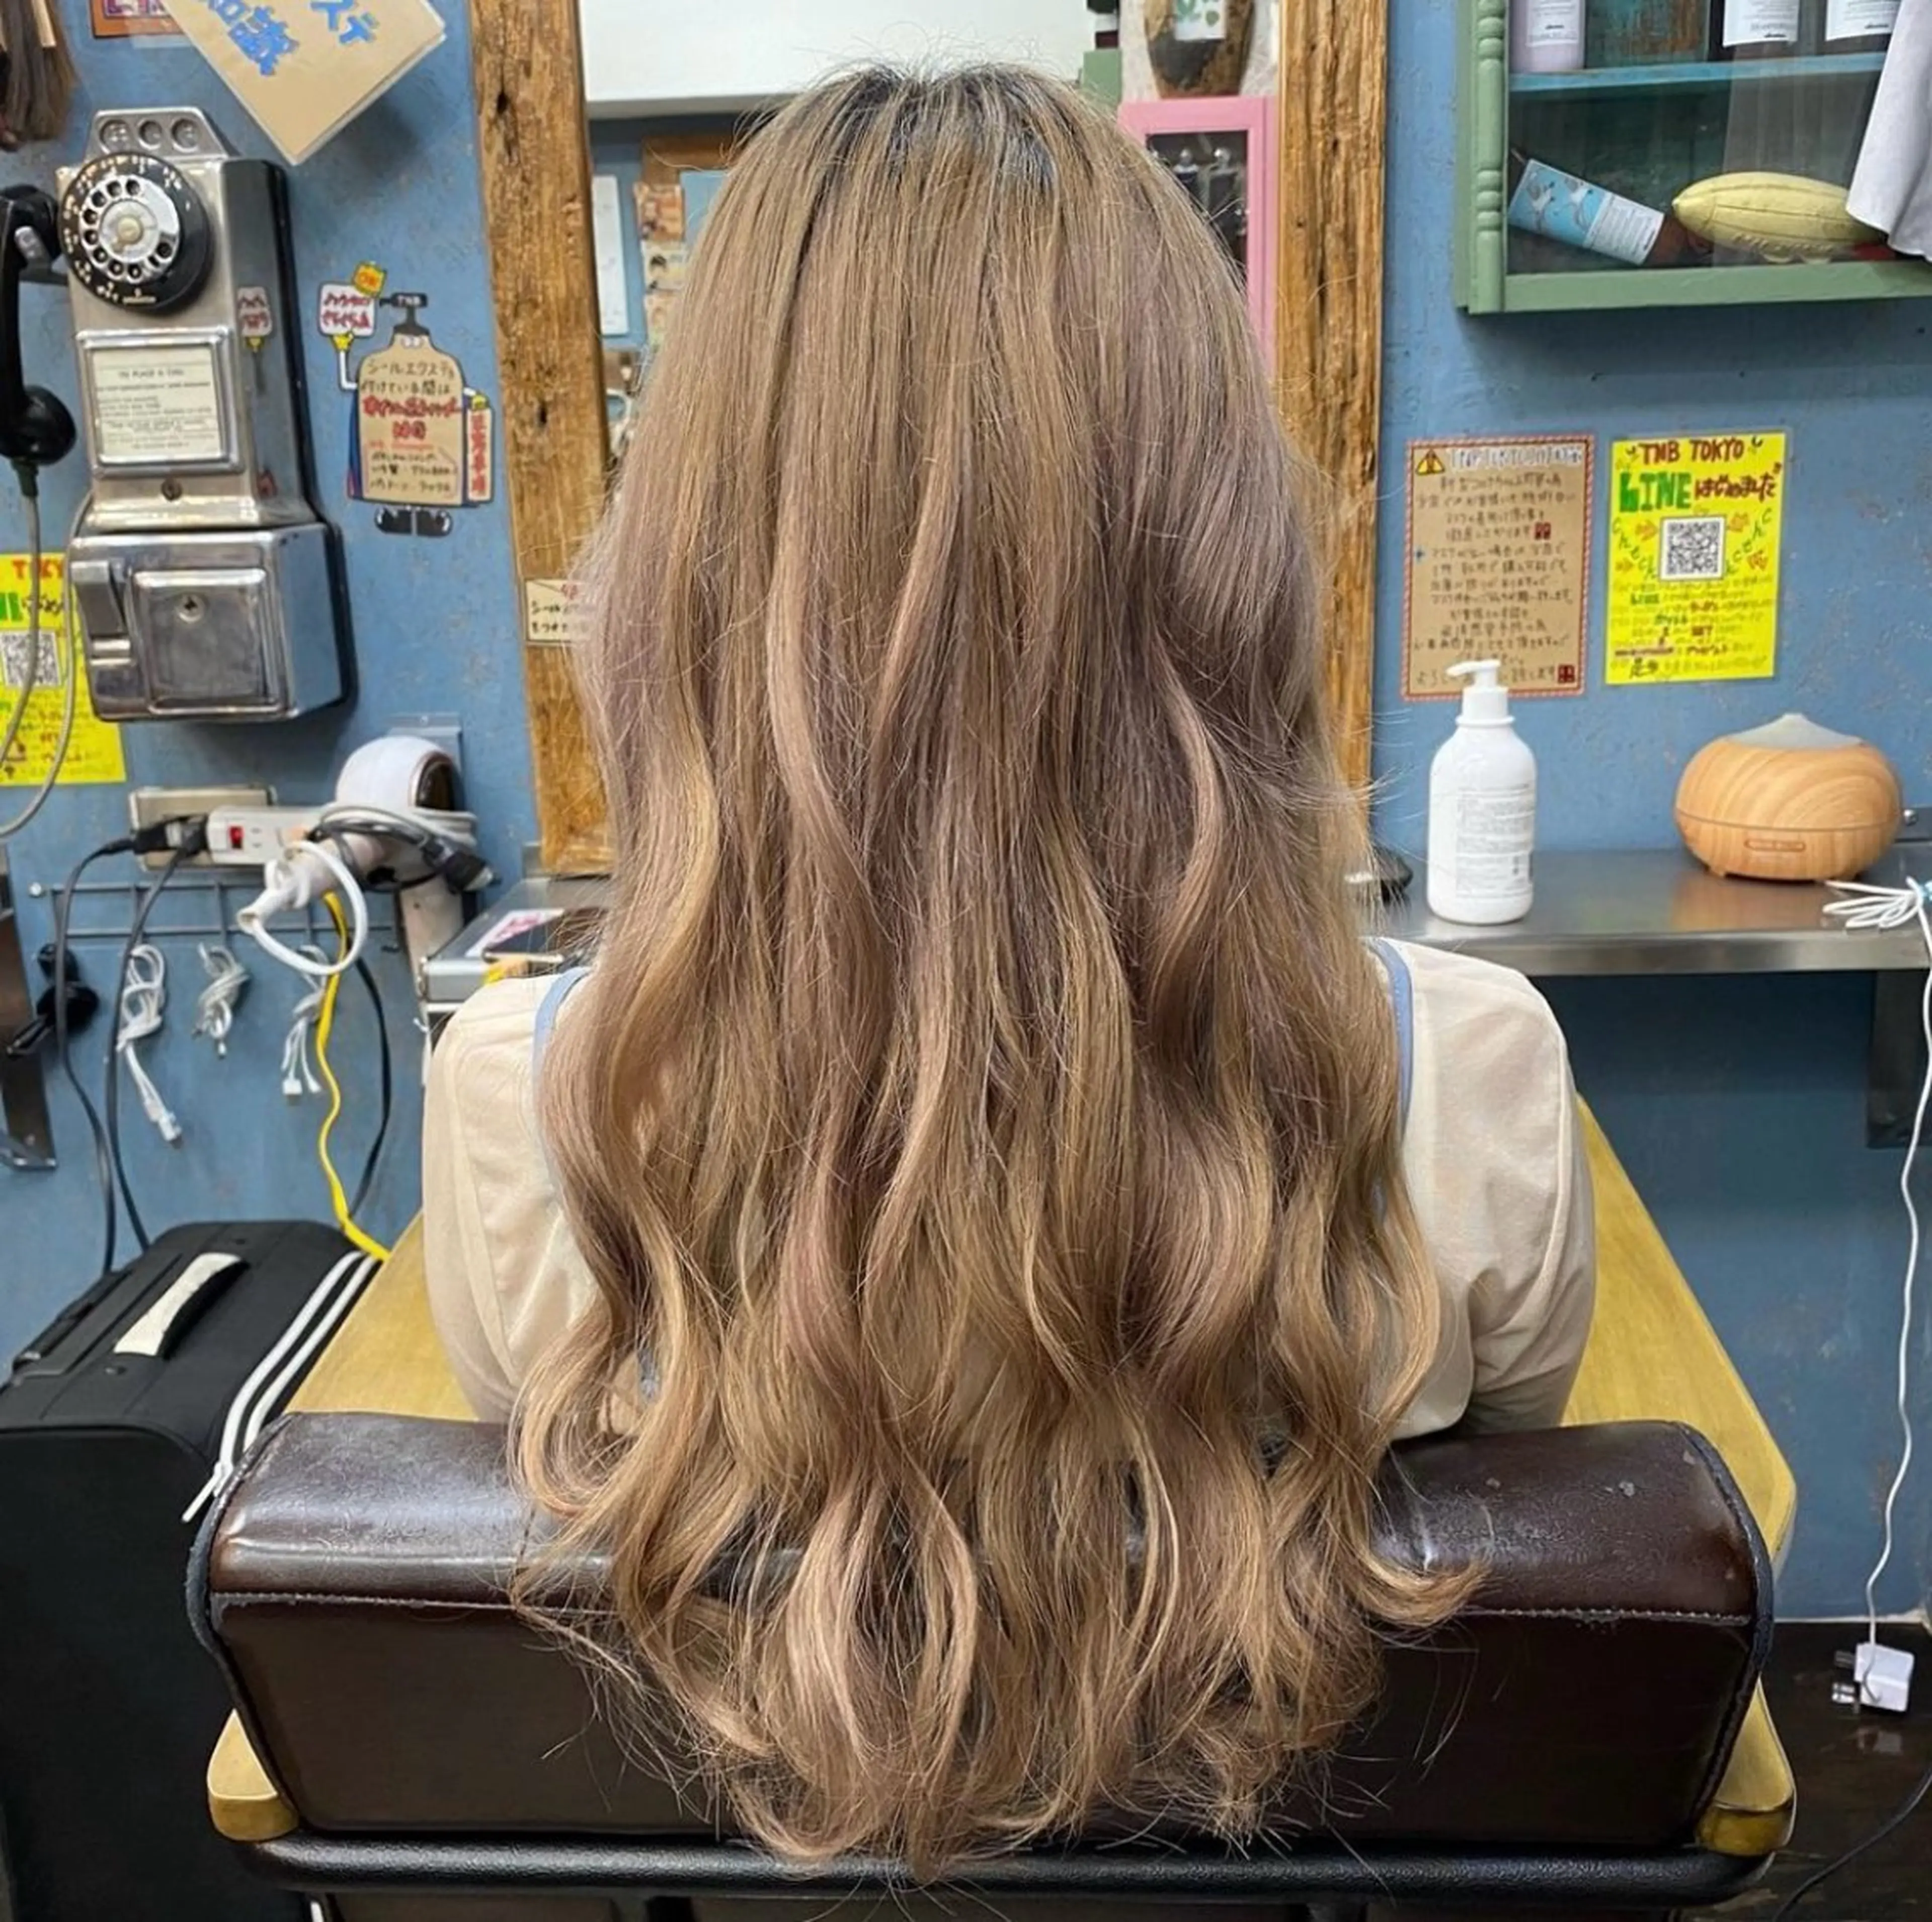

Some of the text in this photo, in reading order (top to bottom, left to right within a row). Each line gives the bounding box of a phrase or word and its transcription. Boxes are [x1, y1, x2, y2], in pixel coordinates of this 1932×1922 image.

[1638, 437, 1744, 465] TNB TOKYO
[1619, 471, 1692, 513] LINE
